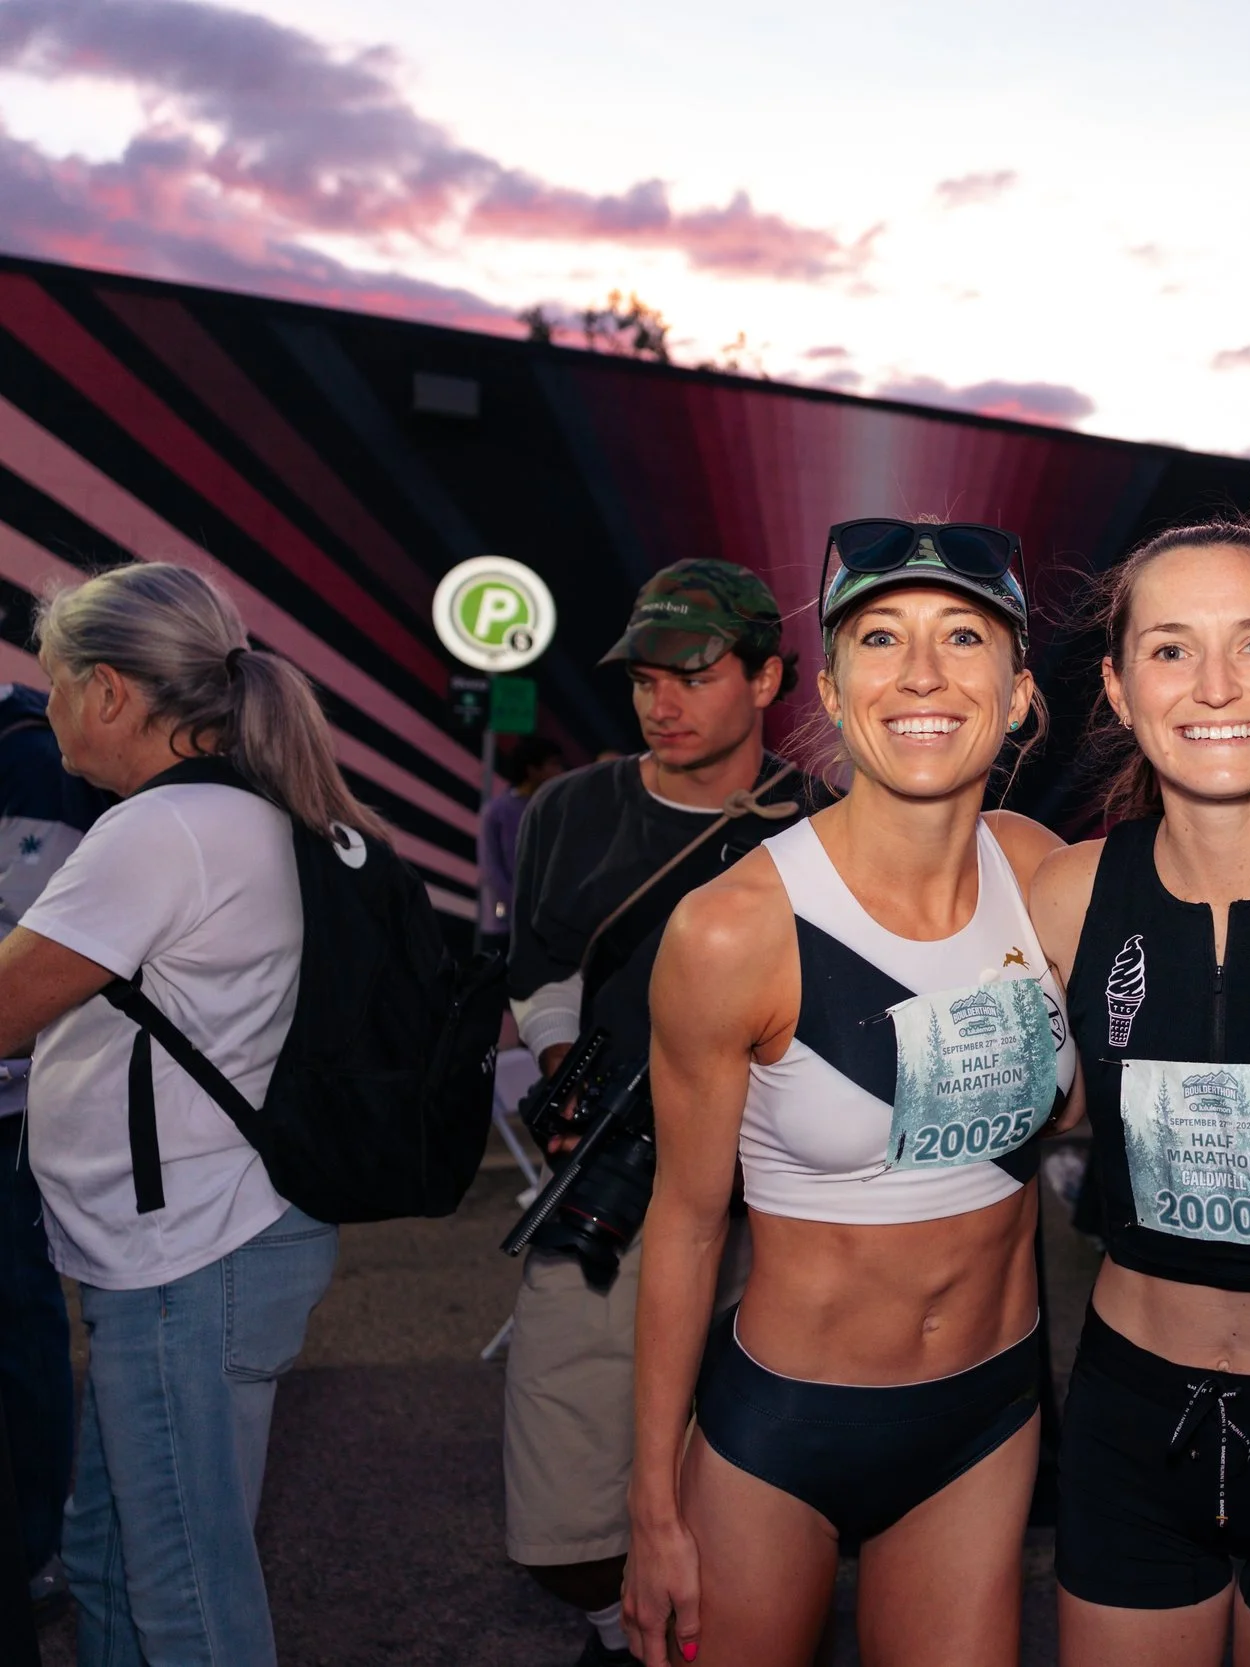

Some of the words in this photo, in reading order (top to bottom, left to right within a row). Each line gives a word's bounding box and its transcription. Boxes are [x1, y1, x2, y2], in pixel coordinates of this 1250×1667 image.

[474, 587, 519, 639] P
[953, 1006, 998, 1023] BOULDERTHON
[942, 1041, 984, 1056] SEPTEMBER
[1001, 1036, 1017, 1045] 2026
[962, 1053, 1000, 1073] HALF
[936, 1068, 1023, 1096] MARATHON
[1184, 1084, 1237, 1099] BOULDERTHON
[1198, 1103, 1232, 1114] lululemon
[1170, 1117, 1217, 1127] SEPTEMBER
[912, 1108, 1035, 1163] 20025
[1191, 1132, 1235, 1148] HALF
[1181, 1170, 1247, 1191] CALDWELL
